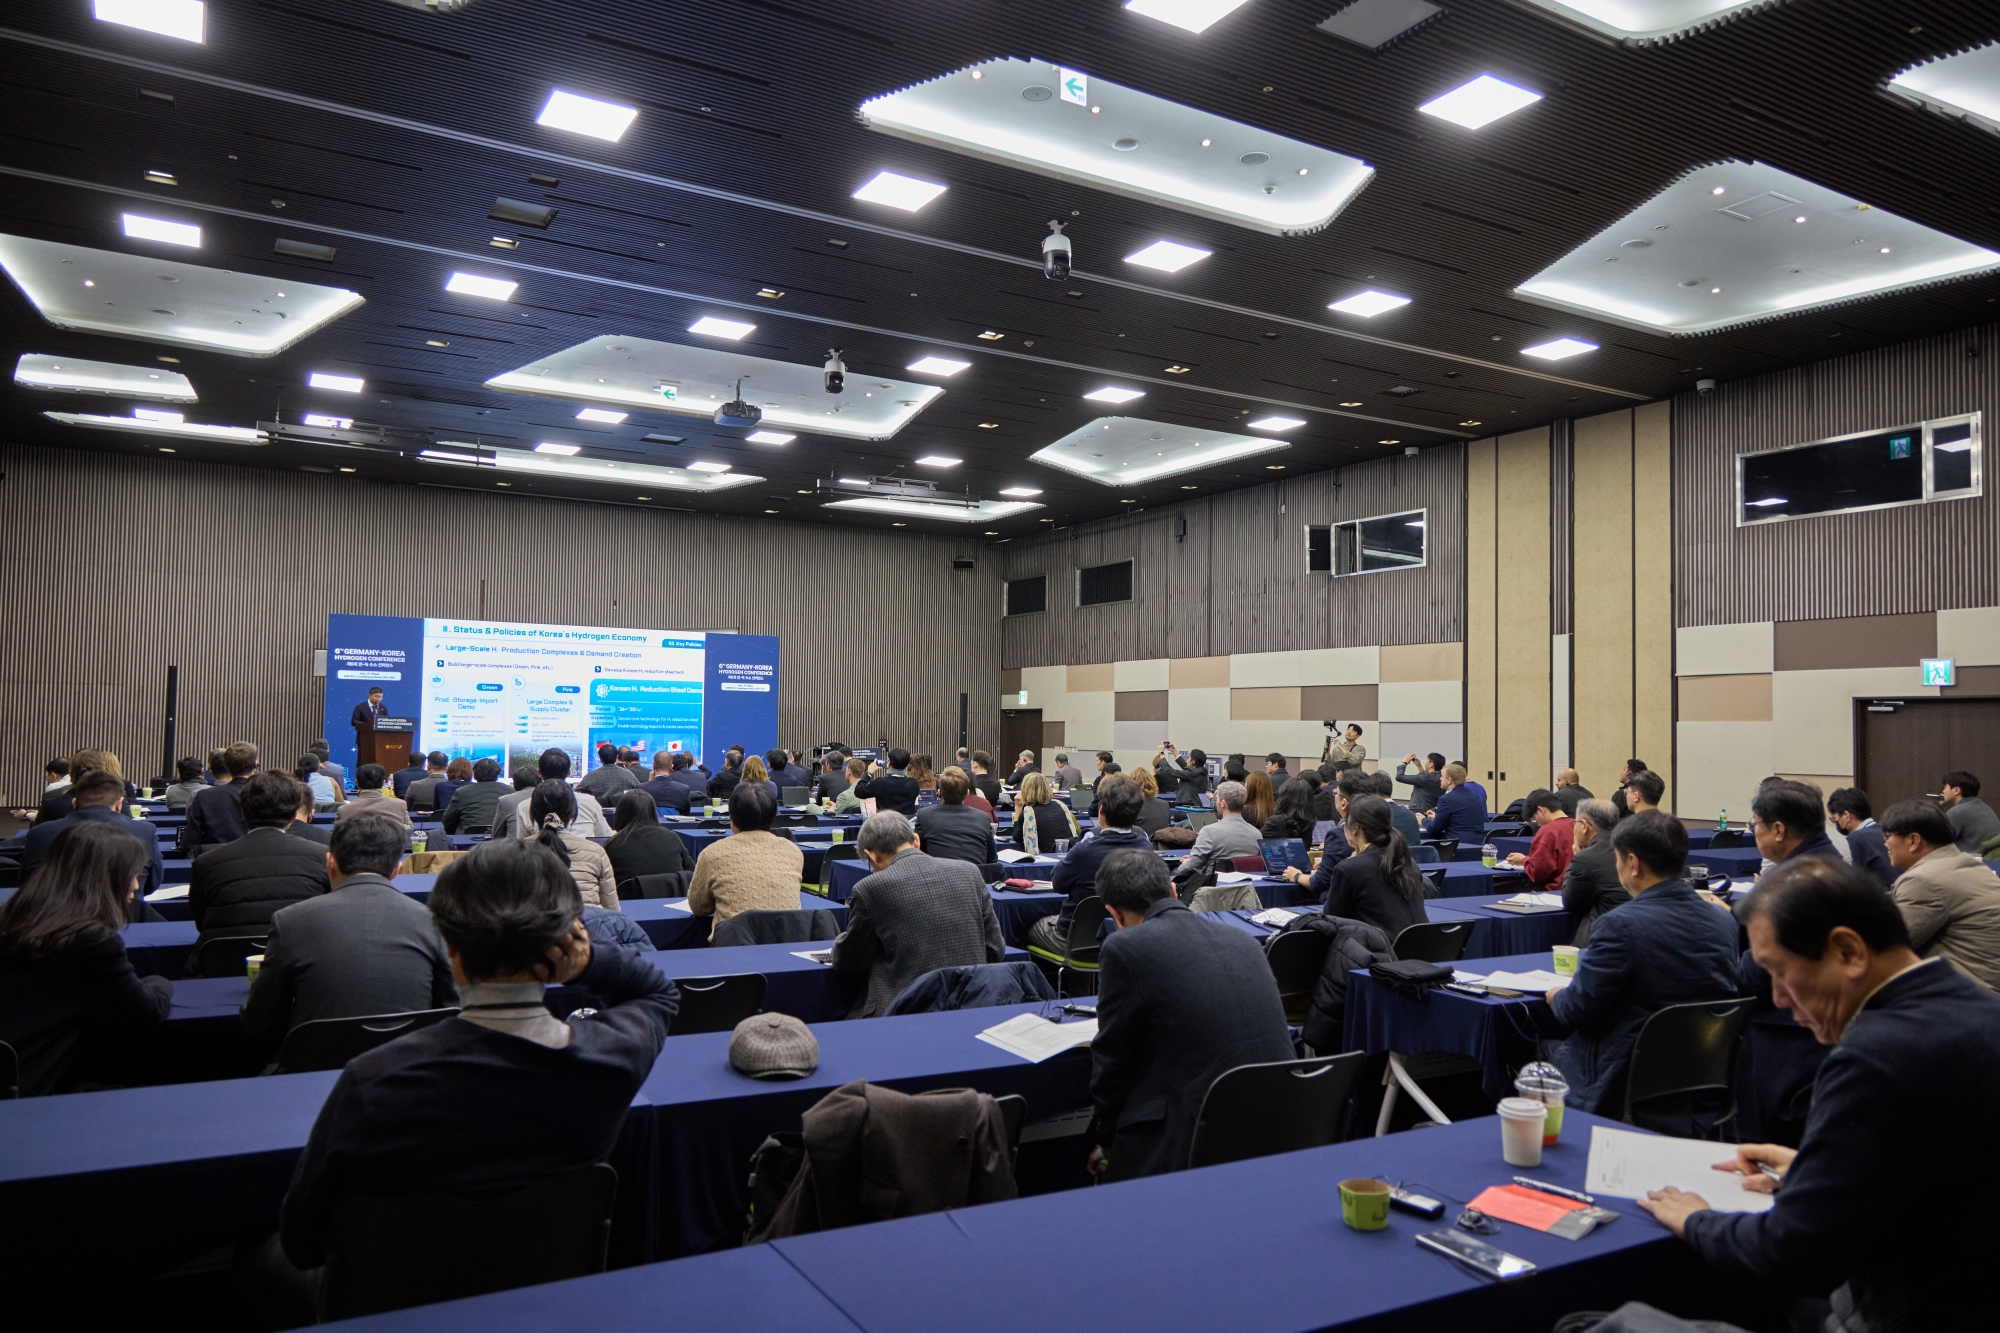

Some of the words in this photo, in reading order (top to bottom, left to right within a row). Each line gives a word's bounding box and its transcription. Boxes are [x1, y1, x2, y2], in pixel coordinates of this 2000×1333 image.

[453, 626, 482, 634] Status
[493, 628, 526, 636] Policies
[572, 632, 610, 641] Hydrogen
[612, 634, 647, 642] Economy
